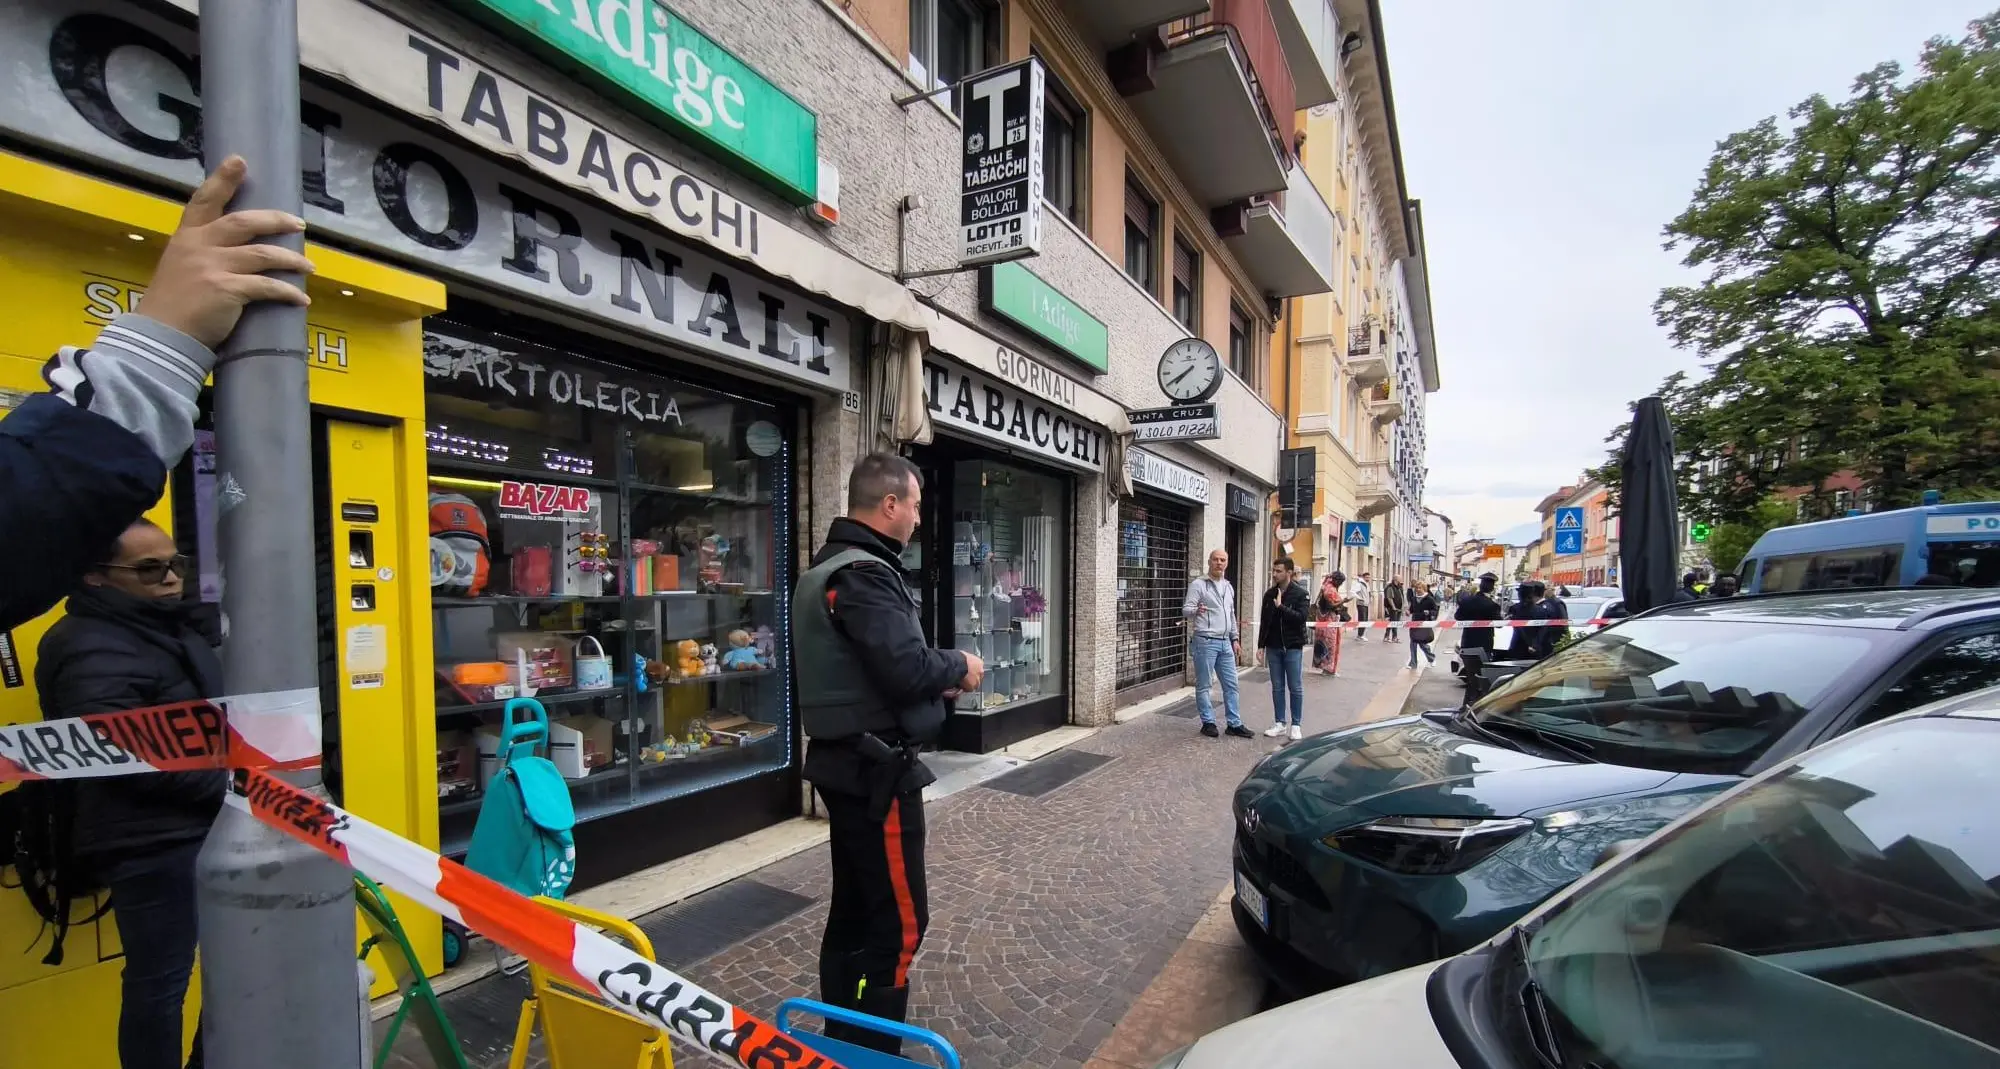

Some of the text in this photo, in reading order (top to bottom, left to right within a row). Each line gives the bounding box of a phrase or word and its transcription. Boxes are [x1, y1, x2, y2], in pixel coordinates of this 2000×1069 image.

[973, 69, 1020, 150] T
[408, 34, 759, 255] TABACCHI
[1012, 128, 1021, 141] 25
[979, 149, 1013, 167] SALI E
[1033, 70, 1043, 242] TABACCHI
[965, 157, 1027, 187] TABACCHI
[971, 199, 1018, 220] BOLLATI
[975, 187, 1016, 206] VALORI
[967, 217, 1021, 242] LOTTO
[996, 346, 1075, 406] GIORNALI
[845, 391, 858, 409] 86
[923, 361, 1101, 466] TABACCHI
[1172, 408, 1204, 418] CRUZ
[1145, 426, 1173, 439] SOLO
[1177, 422, 1213, 437] PIZZA
[1147, 459, 1166, 485] NON
[1168, 468, 1187, 492] SOLO
[499, 480, 590, 515] BAZAR
